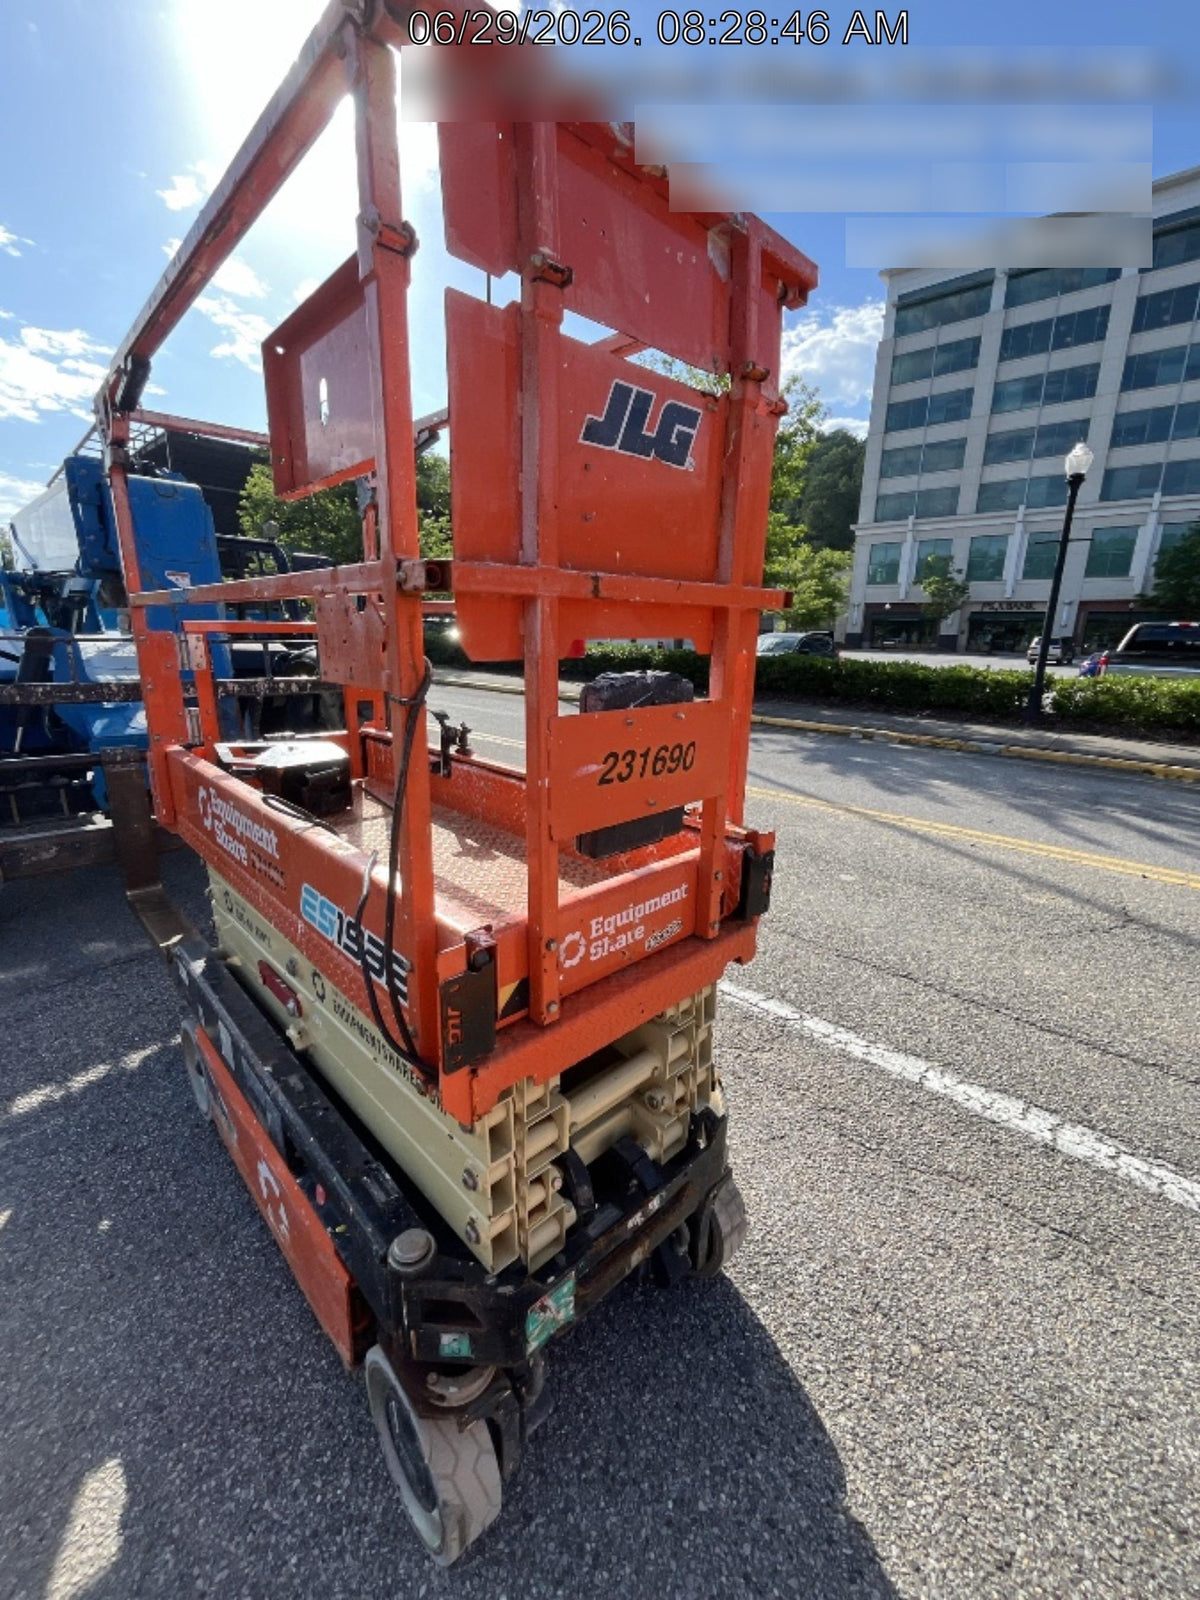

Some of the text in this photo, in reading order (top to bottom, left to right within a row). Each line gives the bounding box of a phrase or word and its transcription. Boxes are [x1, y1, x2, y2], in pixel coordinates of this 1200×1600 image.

[579, 379, 703, 470] JLG
[597, 741, 696, 786] 231690
[590, 883, 689, 939] Equipment
[447, 1006, 463, 1047] JLG
